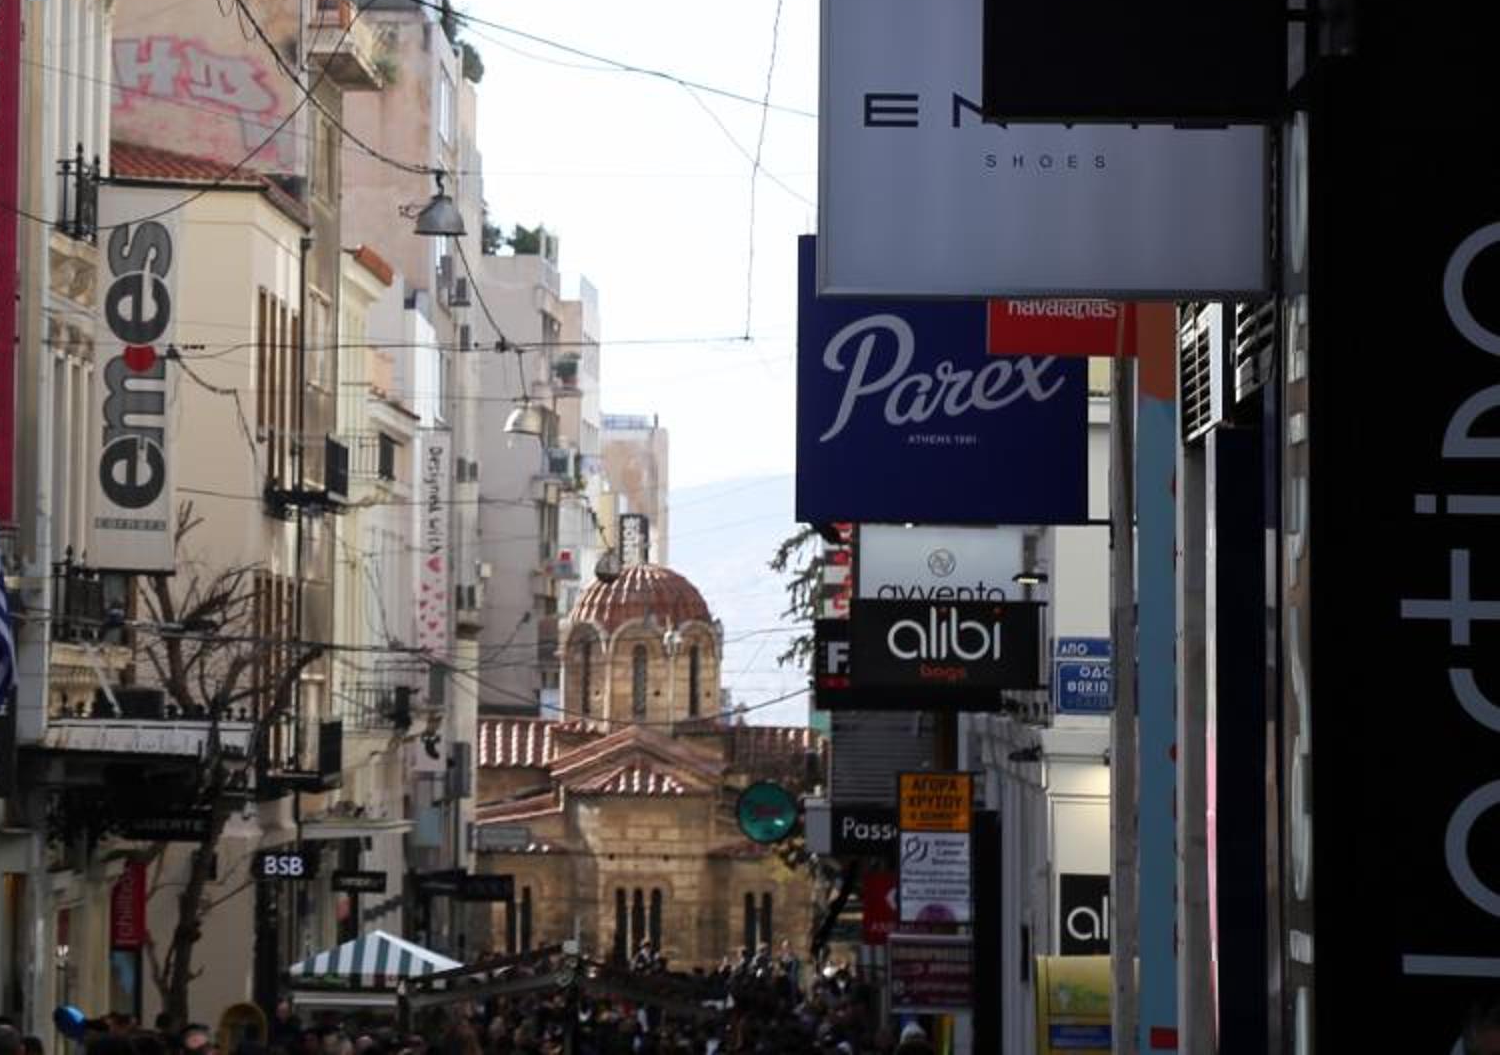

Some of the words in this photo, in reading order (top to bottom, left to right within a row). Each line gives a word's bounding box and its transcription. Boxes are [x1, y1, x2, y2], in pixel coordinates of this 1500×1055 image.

[984, 154, 1106, 169] SHOES
[819, 314, 1066, 443] Parex
[887, 606, 1001, 661] alibi
[843, 816, 897, 840] Pass
[264, 856, 303, 876] BSB
